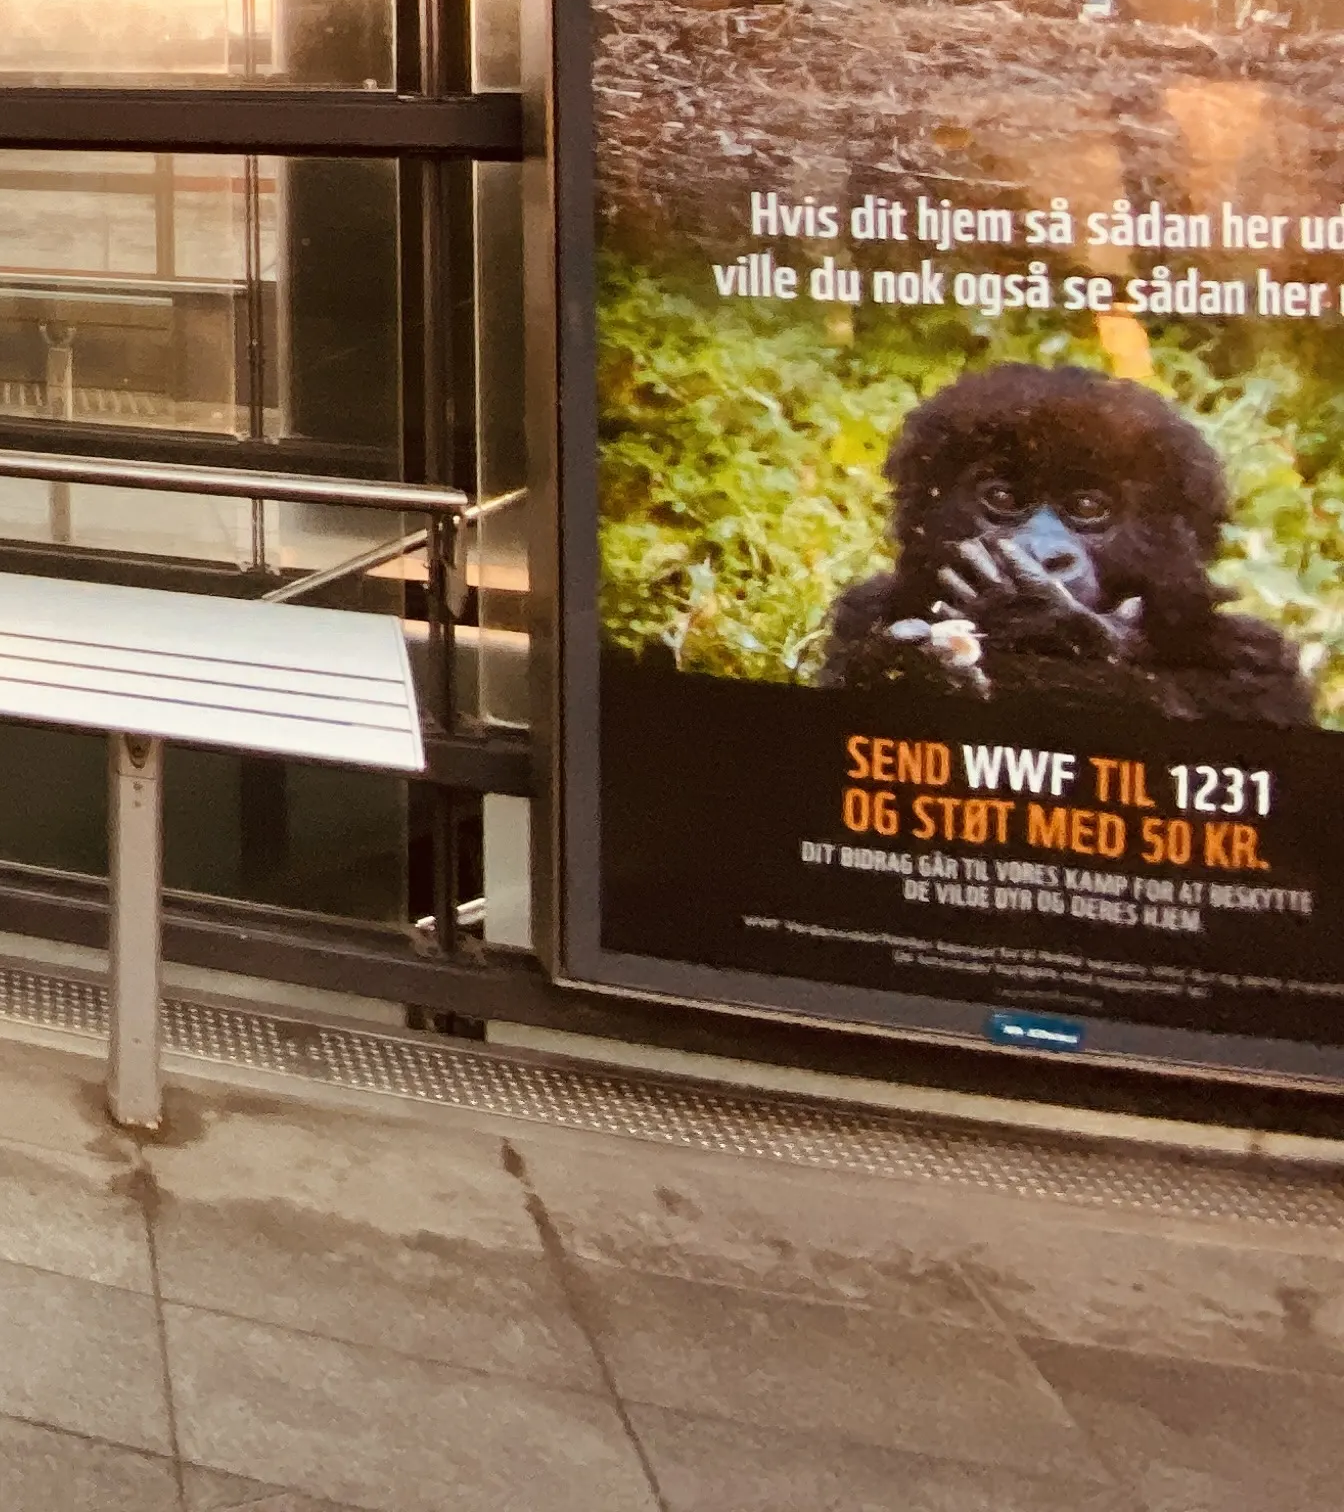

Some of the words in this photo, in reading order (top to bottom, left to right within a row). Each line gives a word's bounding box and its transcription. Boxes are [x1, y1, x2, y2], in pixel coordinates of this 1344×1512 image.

[750, 191, 840, 239] Hvis
[850, 194, 909, 241] dit
[917, 195, 1012, 251] hjem
[1025, 197, 1074, 245] så
[1087, 199, 1211, 248] sådan
[1222, 201, 1289, 249] her
[713, 253, 798, 299] ville
[810, 256, 860, 302] du
[873, 259, 946, 305] nok
[953, 261, 1051, 317] også
[1063, 276, 1113, 312] se
[1126, 265, 1246, 316] sådan
[1257, 268, 1328, 318] her
[846, 735, 951, 787] SEND
[963, 744, 1077, 796] WWF
[1089, 756, 1156, 808] TIL
[1169, 763, 1273, 818] 1231
[842, 788, 900, 837] OG
[912, 795, 1016, 846] STØT
[1026, 801, 1127, 860] MED
[1142, 816, 1192, 866] 50
[1203, 820, 1271, 871] KR.
[801, 840, 836, 865] DIT
[840, 846, 912, 875] BIDRAG
[918, 851, 959, 880] GÅR
[962, 858, 990, 882] TIL
[1064, 867, 1128, 896] KAMP
[1133, 876, 1174, 903] FOR
[904, 879, 931, 902] DE
[935, 882, 990, 908] VILDE
